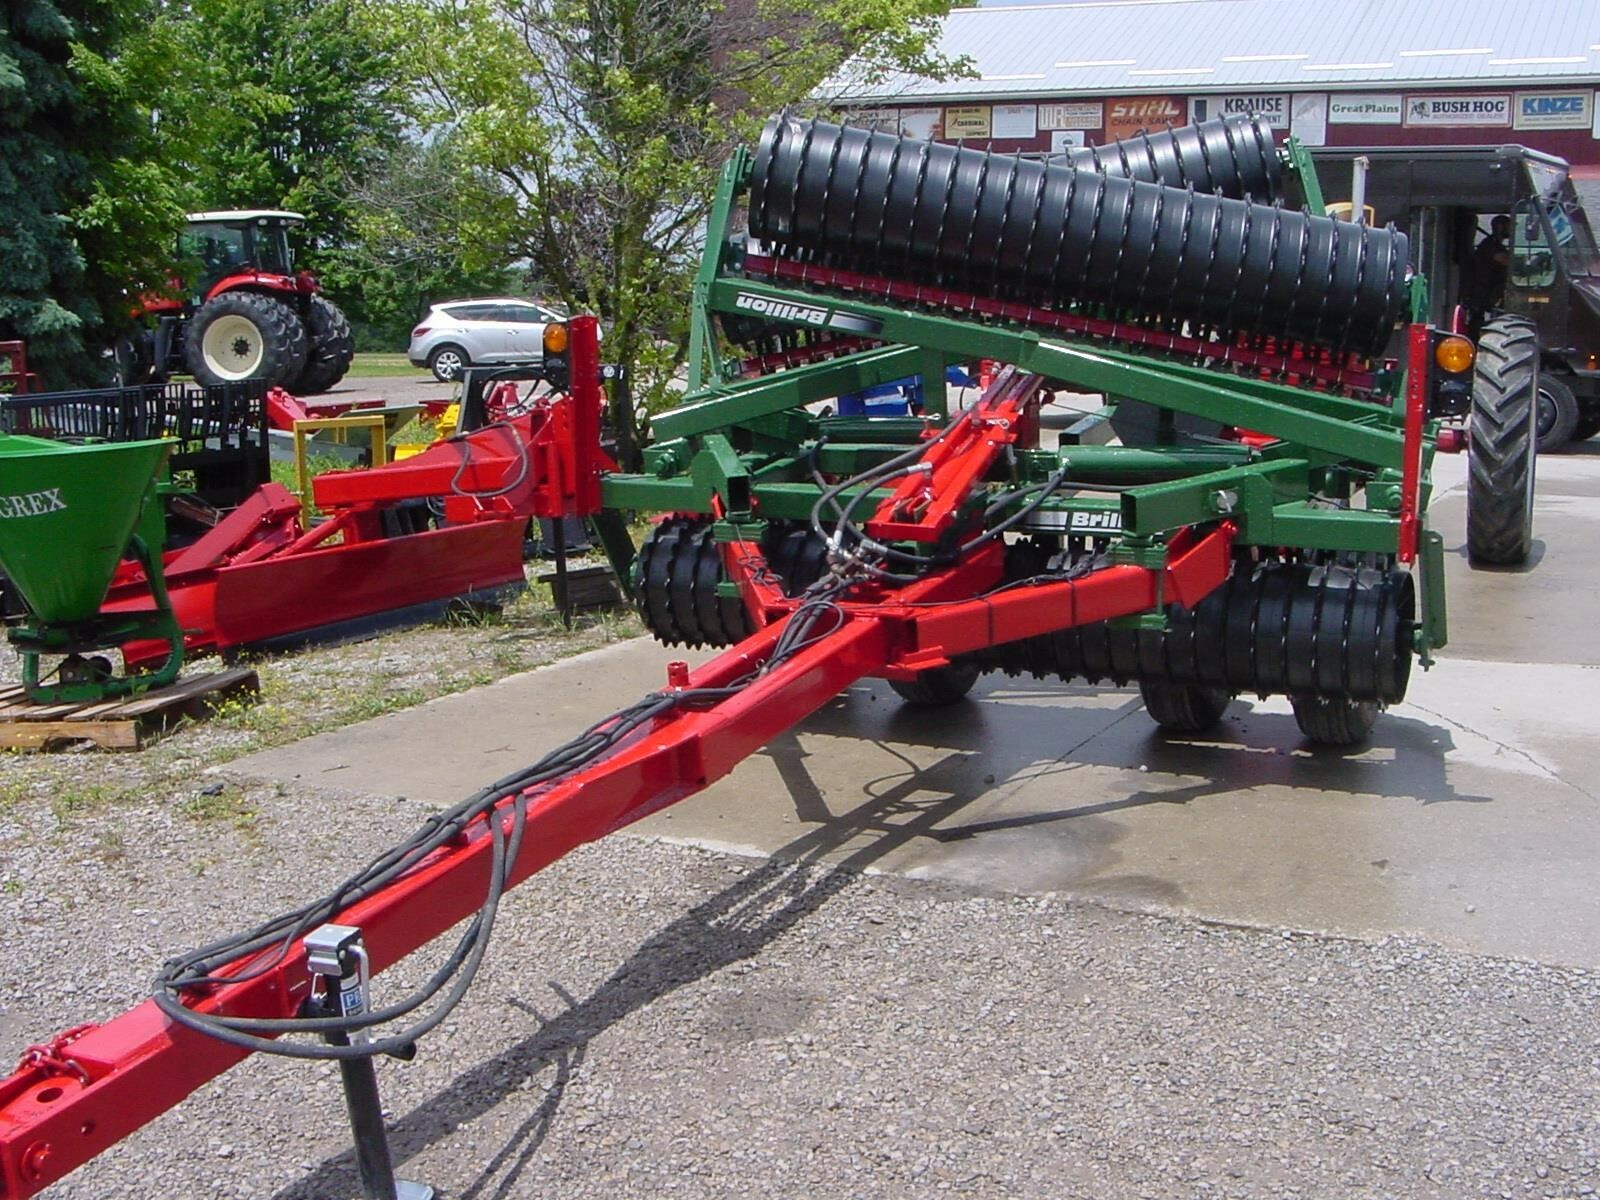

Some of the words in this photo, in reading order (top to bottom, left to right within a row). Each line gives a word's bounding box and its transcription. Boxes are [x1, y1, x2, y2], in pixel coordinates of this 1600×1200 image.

[1111, 101, 1180, 117] STIHL
[1224, 98, 1282, 113] KRAUSE
[1332, 104, 1363, 113] Great
[1365, 104, 1400, 113] Plains
[1432, 101, 1470, 113] BUSH
[1473, 101, 1505, 113] HOG
[1522, 96, 1584, 113] KINZE
[736, 296, 827, 324] Brillion
